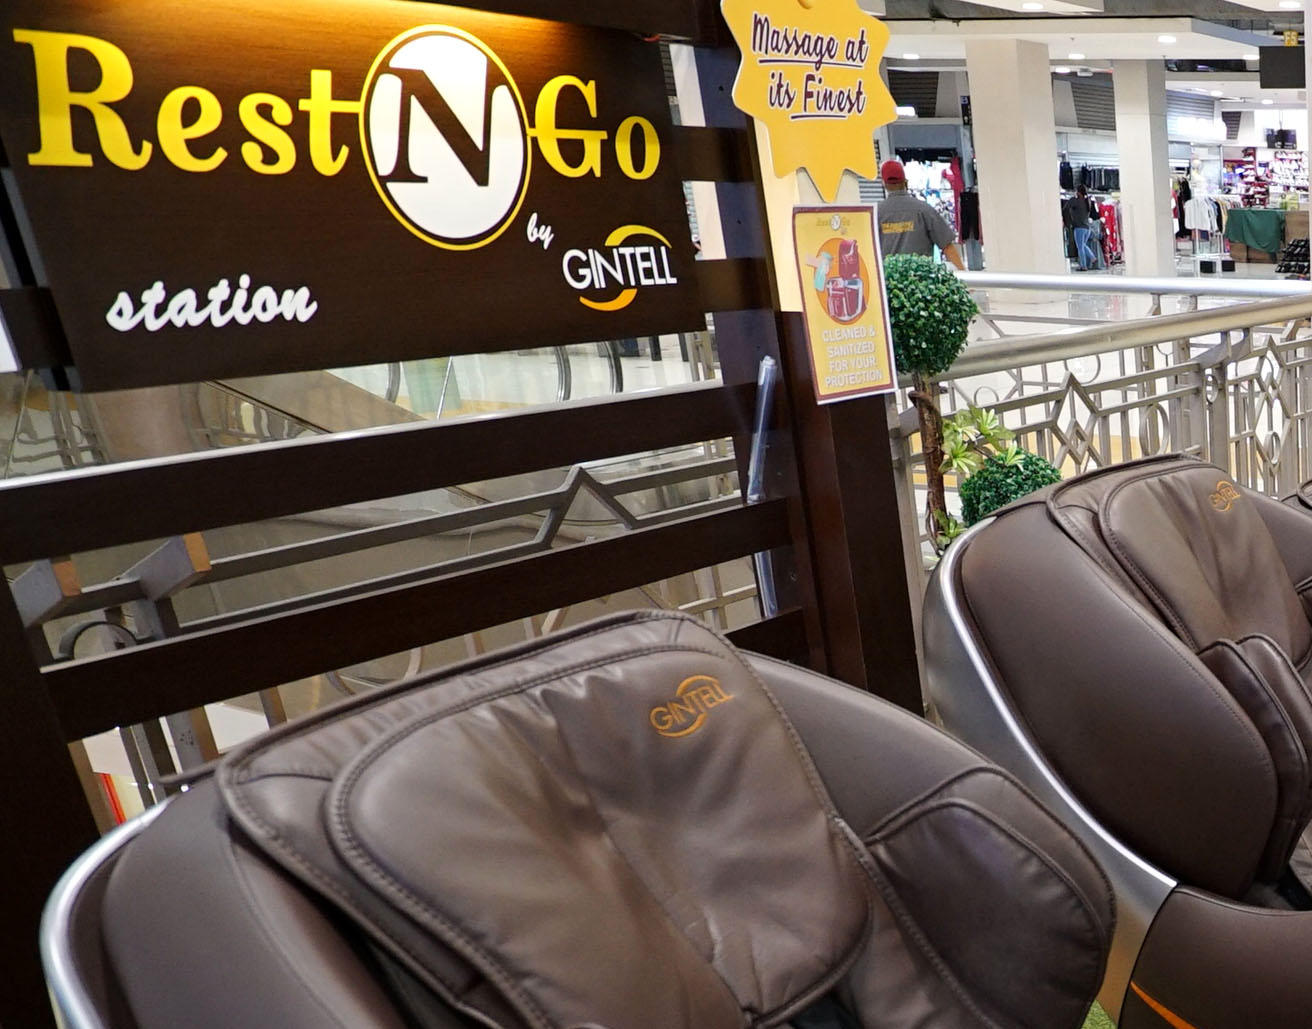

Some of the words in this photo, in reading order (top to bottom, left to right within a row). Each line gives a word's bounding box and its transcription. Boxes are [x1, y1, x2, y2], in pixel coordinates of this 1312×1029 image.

[752, 13, 838, 71] Massage
[846, 29, 868, 63] at
[13, 29, 362, 176] Rest
[527, 74, 661, 180] Go
[769, 72, 796, 108] its
[804, 74, 866, 114] Finest
[527, 212, 554, 250] by
[562, 246, 677, 290] GINTELL
[106, 274, 318, 332] station
[823, 327, 866, 342] CLEANED
[828, 342, 875, 358] SANITIZED
[825, 370, 882, 387] PROTECTION
[829, 360, 848, 372] FOR
[852, 357, 876, 369] YOUR
[650, 684, 734, 731] GINTELL
